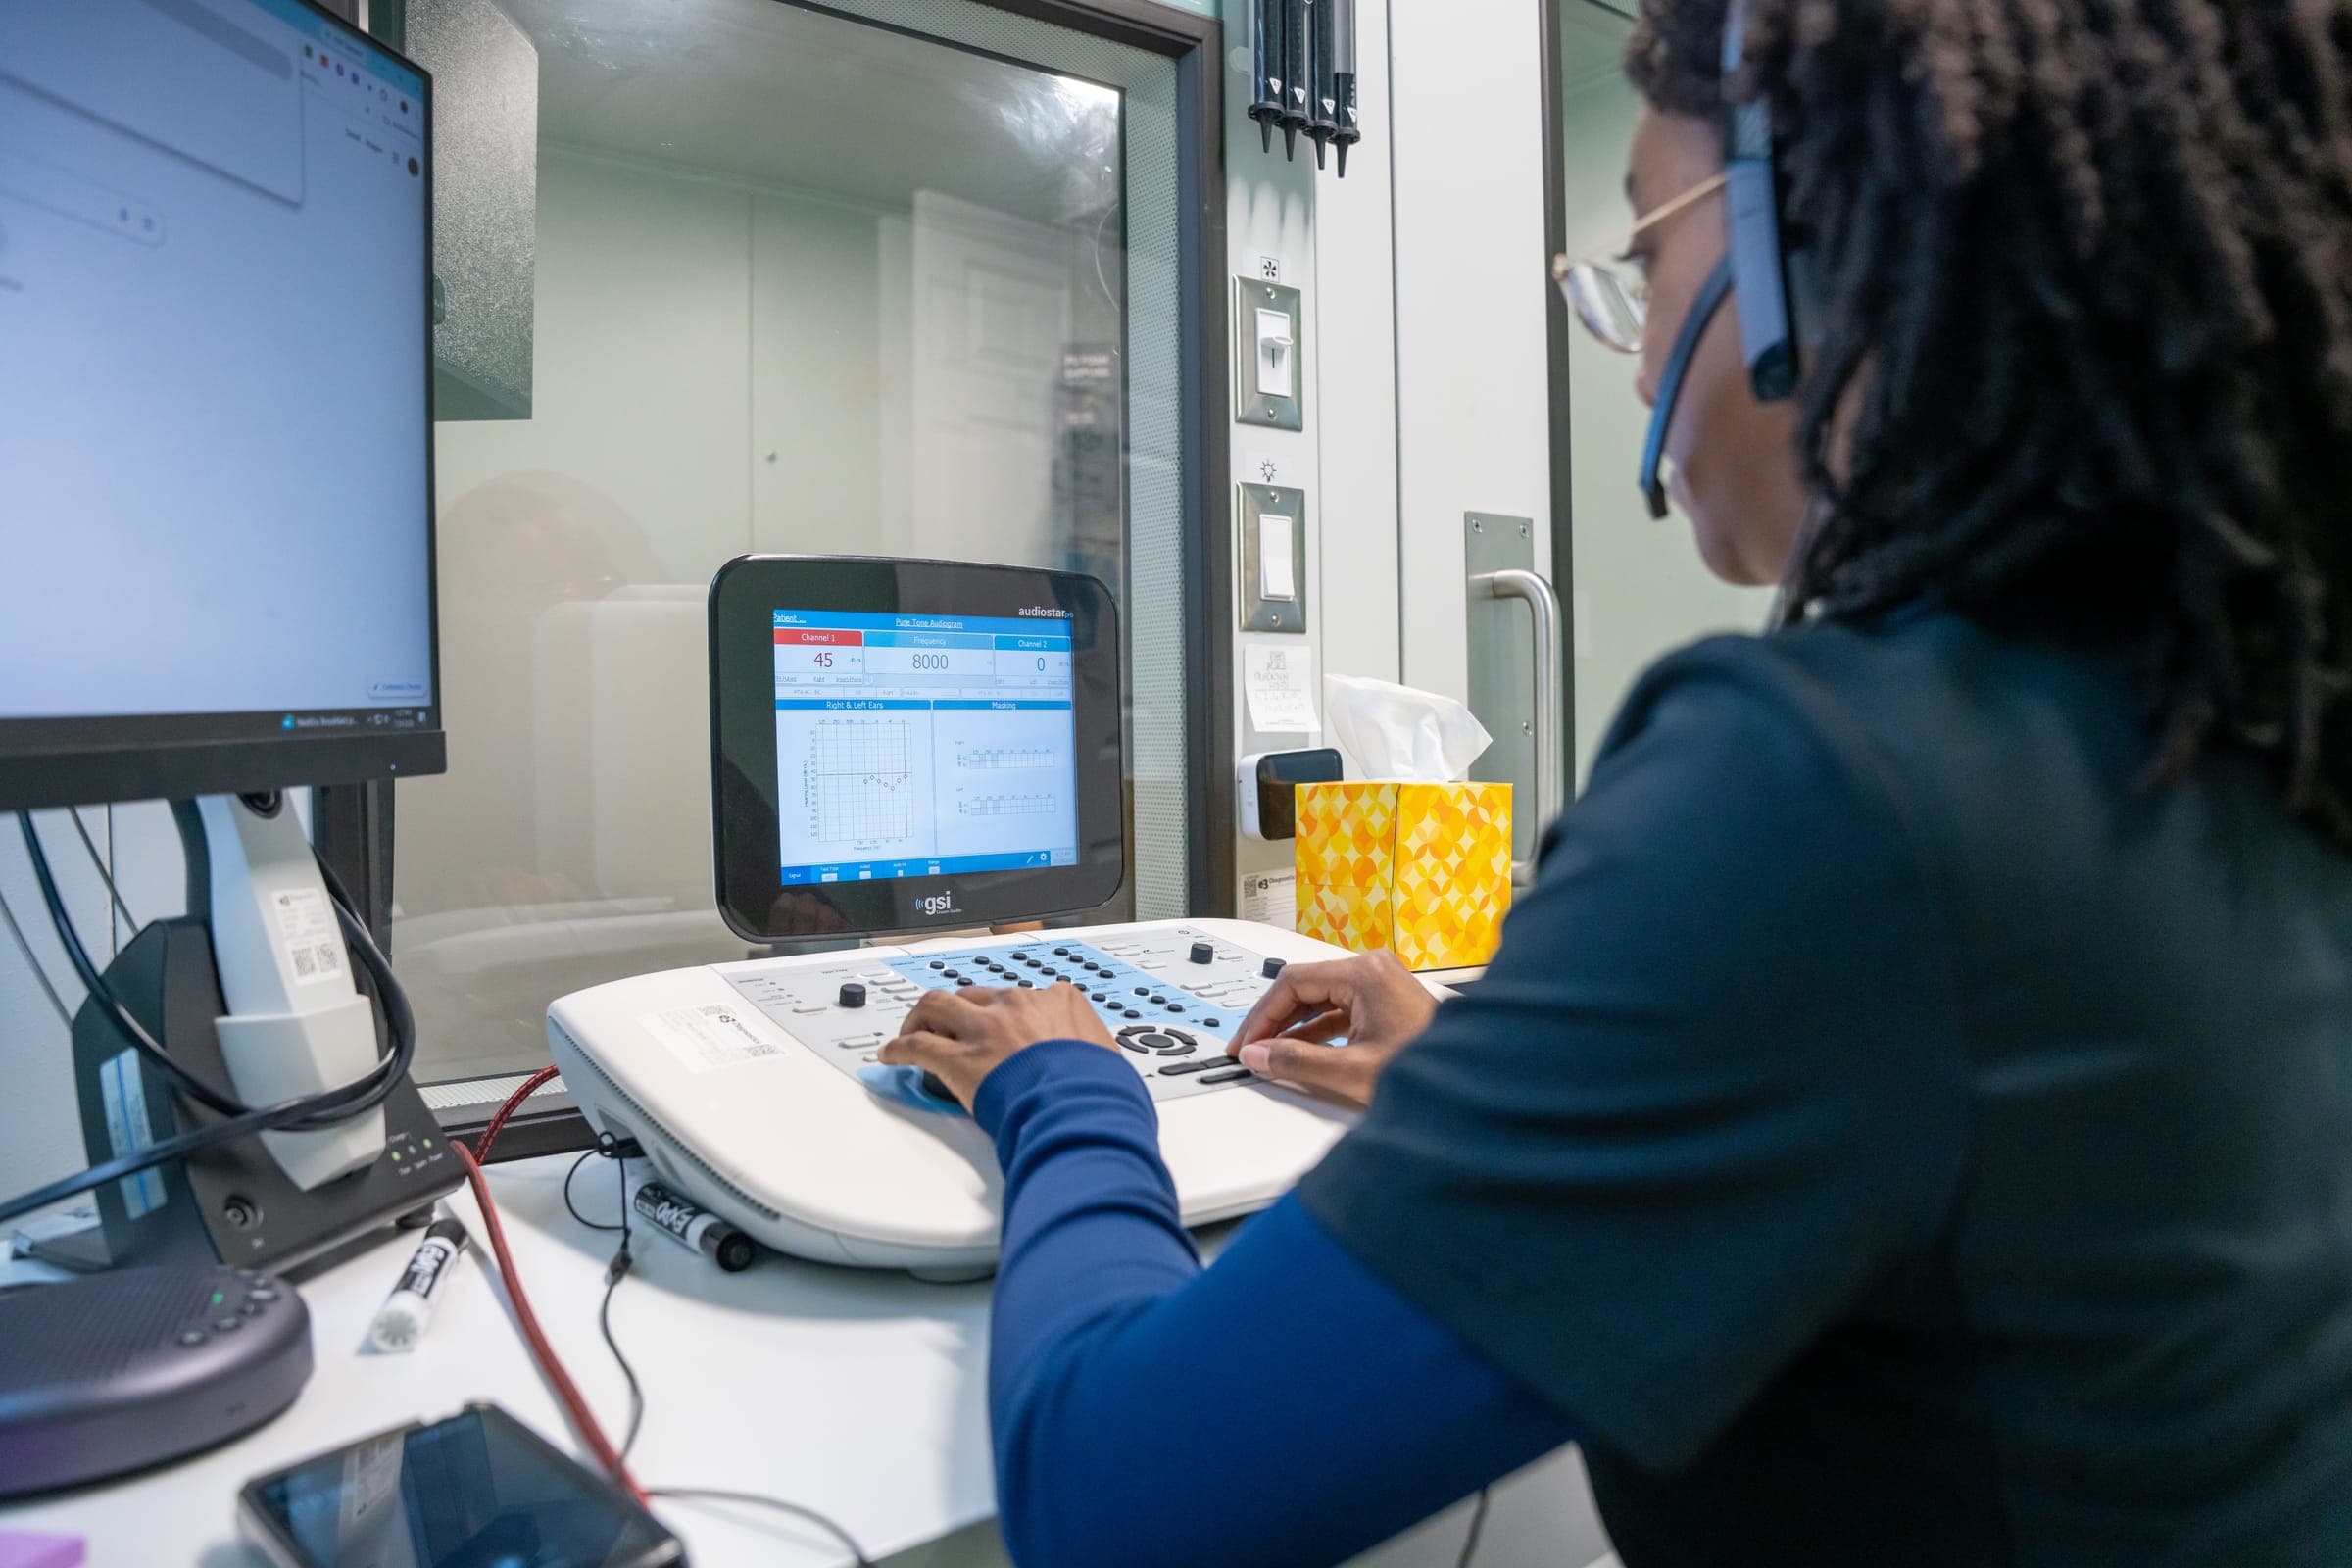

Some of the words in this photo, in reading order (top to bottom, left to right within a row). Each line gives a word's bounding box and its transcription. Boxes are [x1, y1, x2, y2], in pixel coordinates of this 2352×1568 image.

[1018, 606, 1066, 617] audiostar
[912, 618, 929, 627] Tone
[801, 633, 830, 642] Channel
[913, 636, 947, 647] Frequency
[813, 653, 833, 667] 45
[912, 654, 949, 670] 8000
[1037, 657, 1046, 671] 0
[826, 701, 844, 710] Right
[992, 702, 1016, 710] Masking
[924, 890, 951, 915] gsi
[656, 1201, 696, 1234] EXPO
